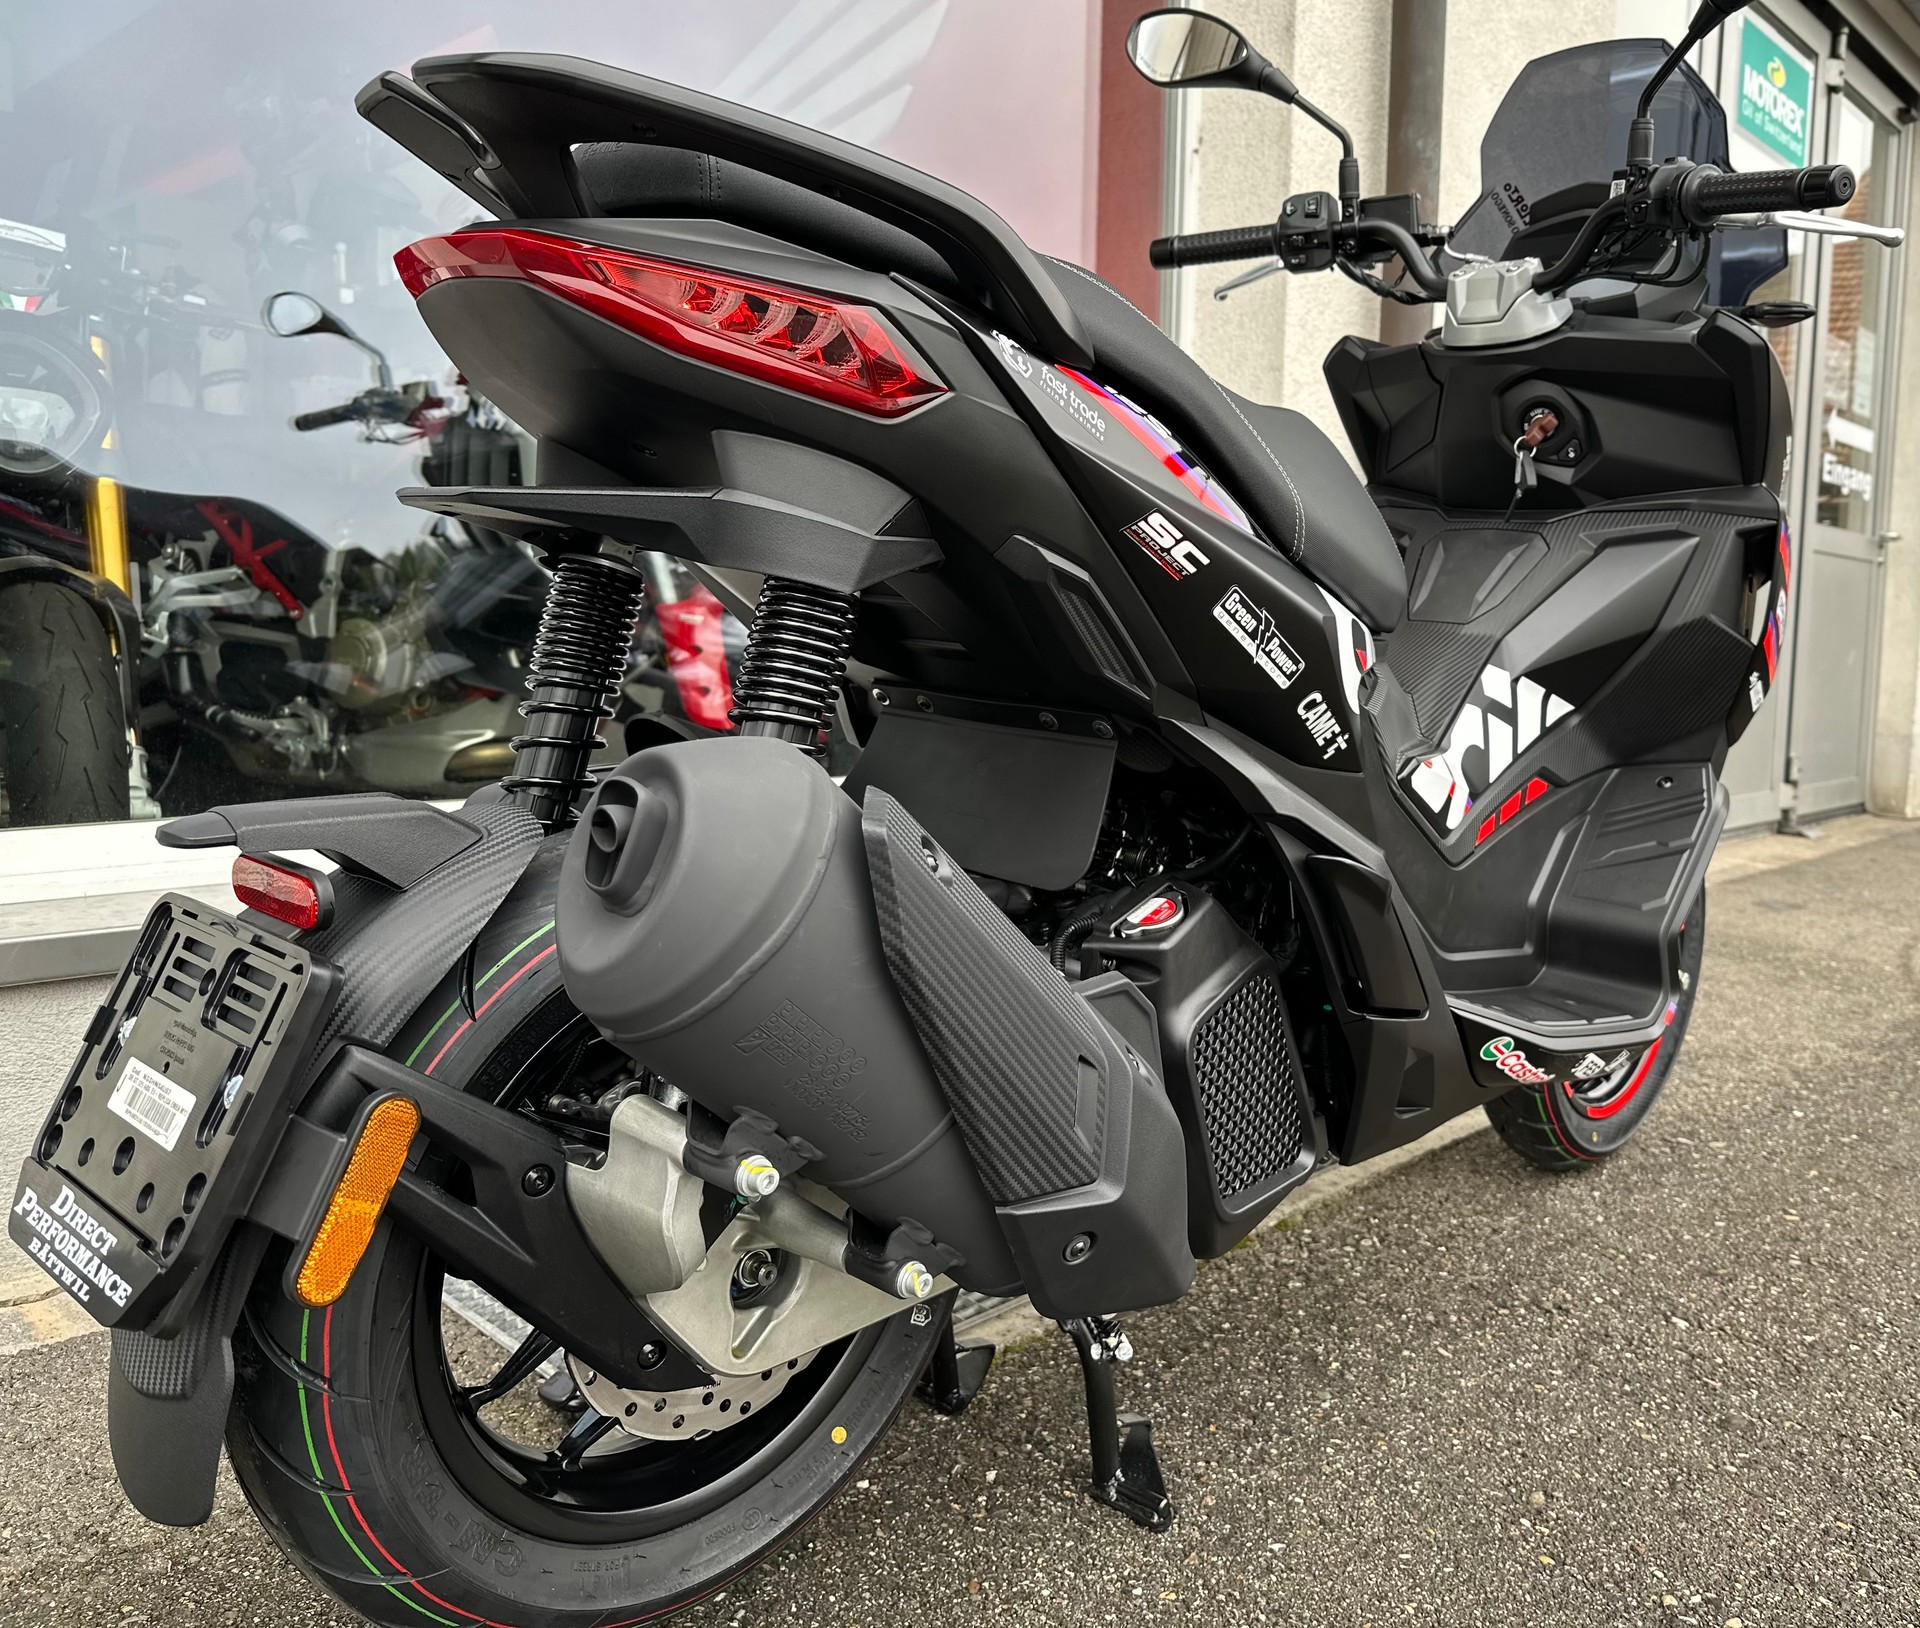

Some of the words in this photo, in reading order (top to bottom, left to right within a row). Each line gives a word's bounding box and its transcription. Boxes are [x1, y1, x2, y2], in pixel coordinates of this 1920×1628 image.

[1743, 63, 1804, 139] MOTOREX
[1039, 380, 1065, 406] fixing
[1069, 405, 1105, 442] business
[1041, 366, 1069, 399] fast
[1070, 389, 1106, 432] trade
[1822, 452, 1872, 501] Eingang
[1131, 525, 1190, 576] PROJECT
[1137, 512, 1211, 574] SC
[1224, 592, 1257, 632] Green
[1265, 636, 1298, 676] Power
[13, 1186, 133, 1307] PERFORMANCE
[49, 1184, 118, 1256] DIRECT
[28, 1236, 90, 1302] BÄTTWIL
